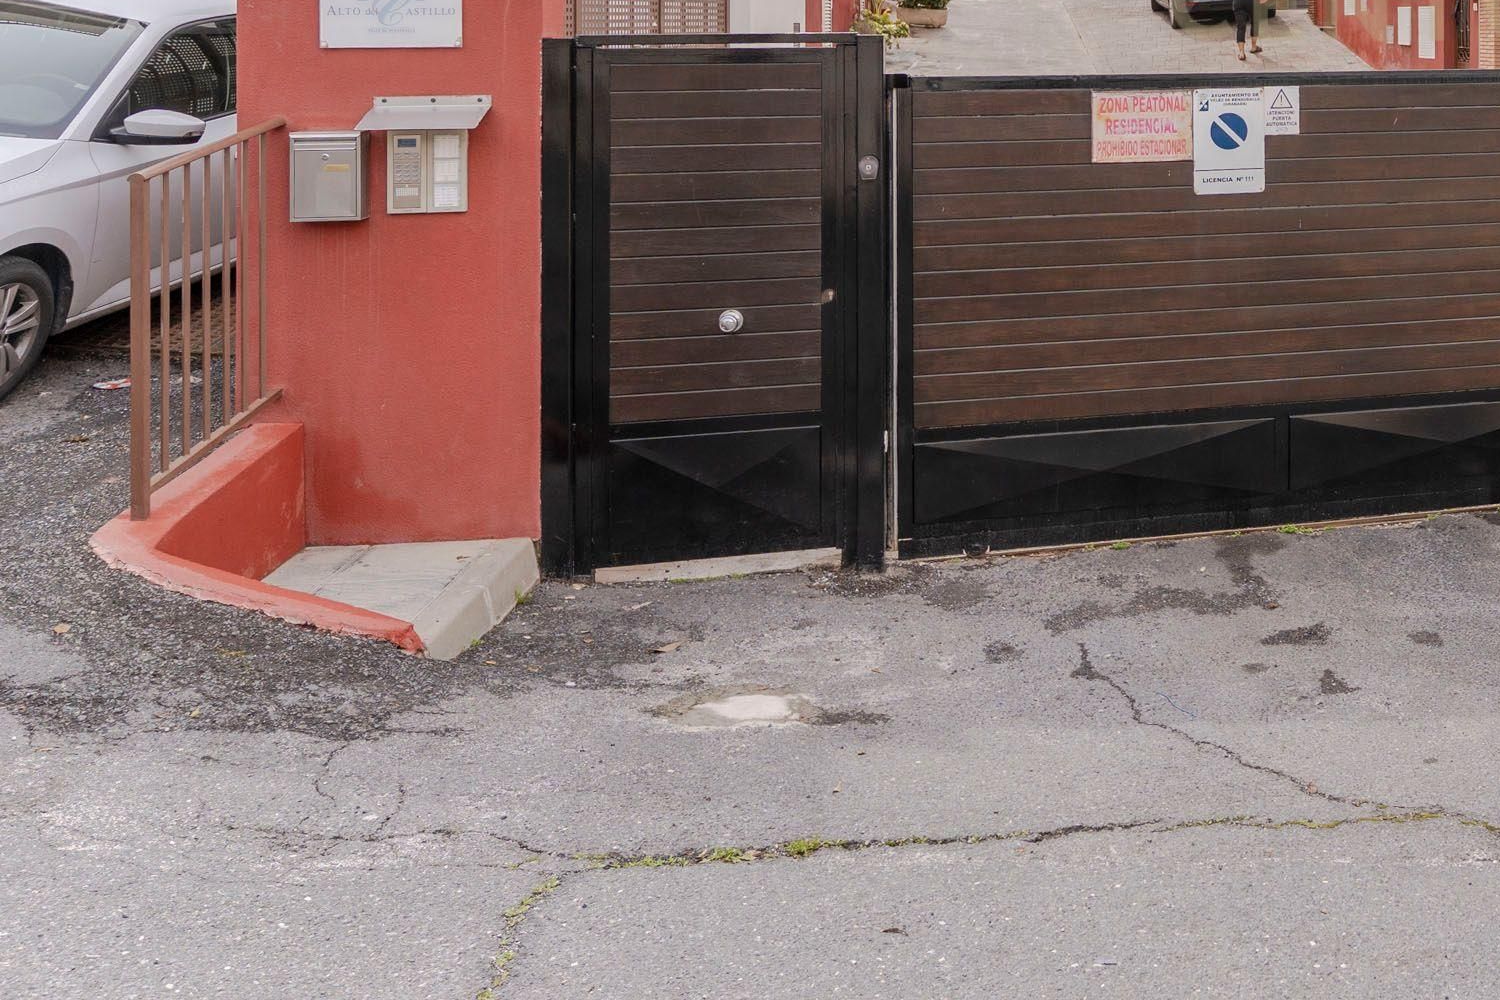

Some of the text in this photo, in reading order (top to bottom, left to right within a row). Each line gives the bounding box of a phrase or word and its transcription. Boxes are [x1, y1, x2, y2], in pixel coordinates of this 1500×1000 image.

[1100, 96, 1186, 113] ZONA PEATONAL
[1105, 117, 1178, 135] RESIDENCIAL
[1097, 138, 1187, 157] PROHIBIDO ESTACIONAR
